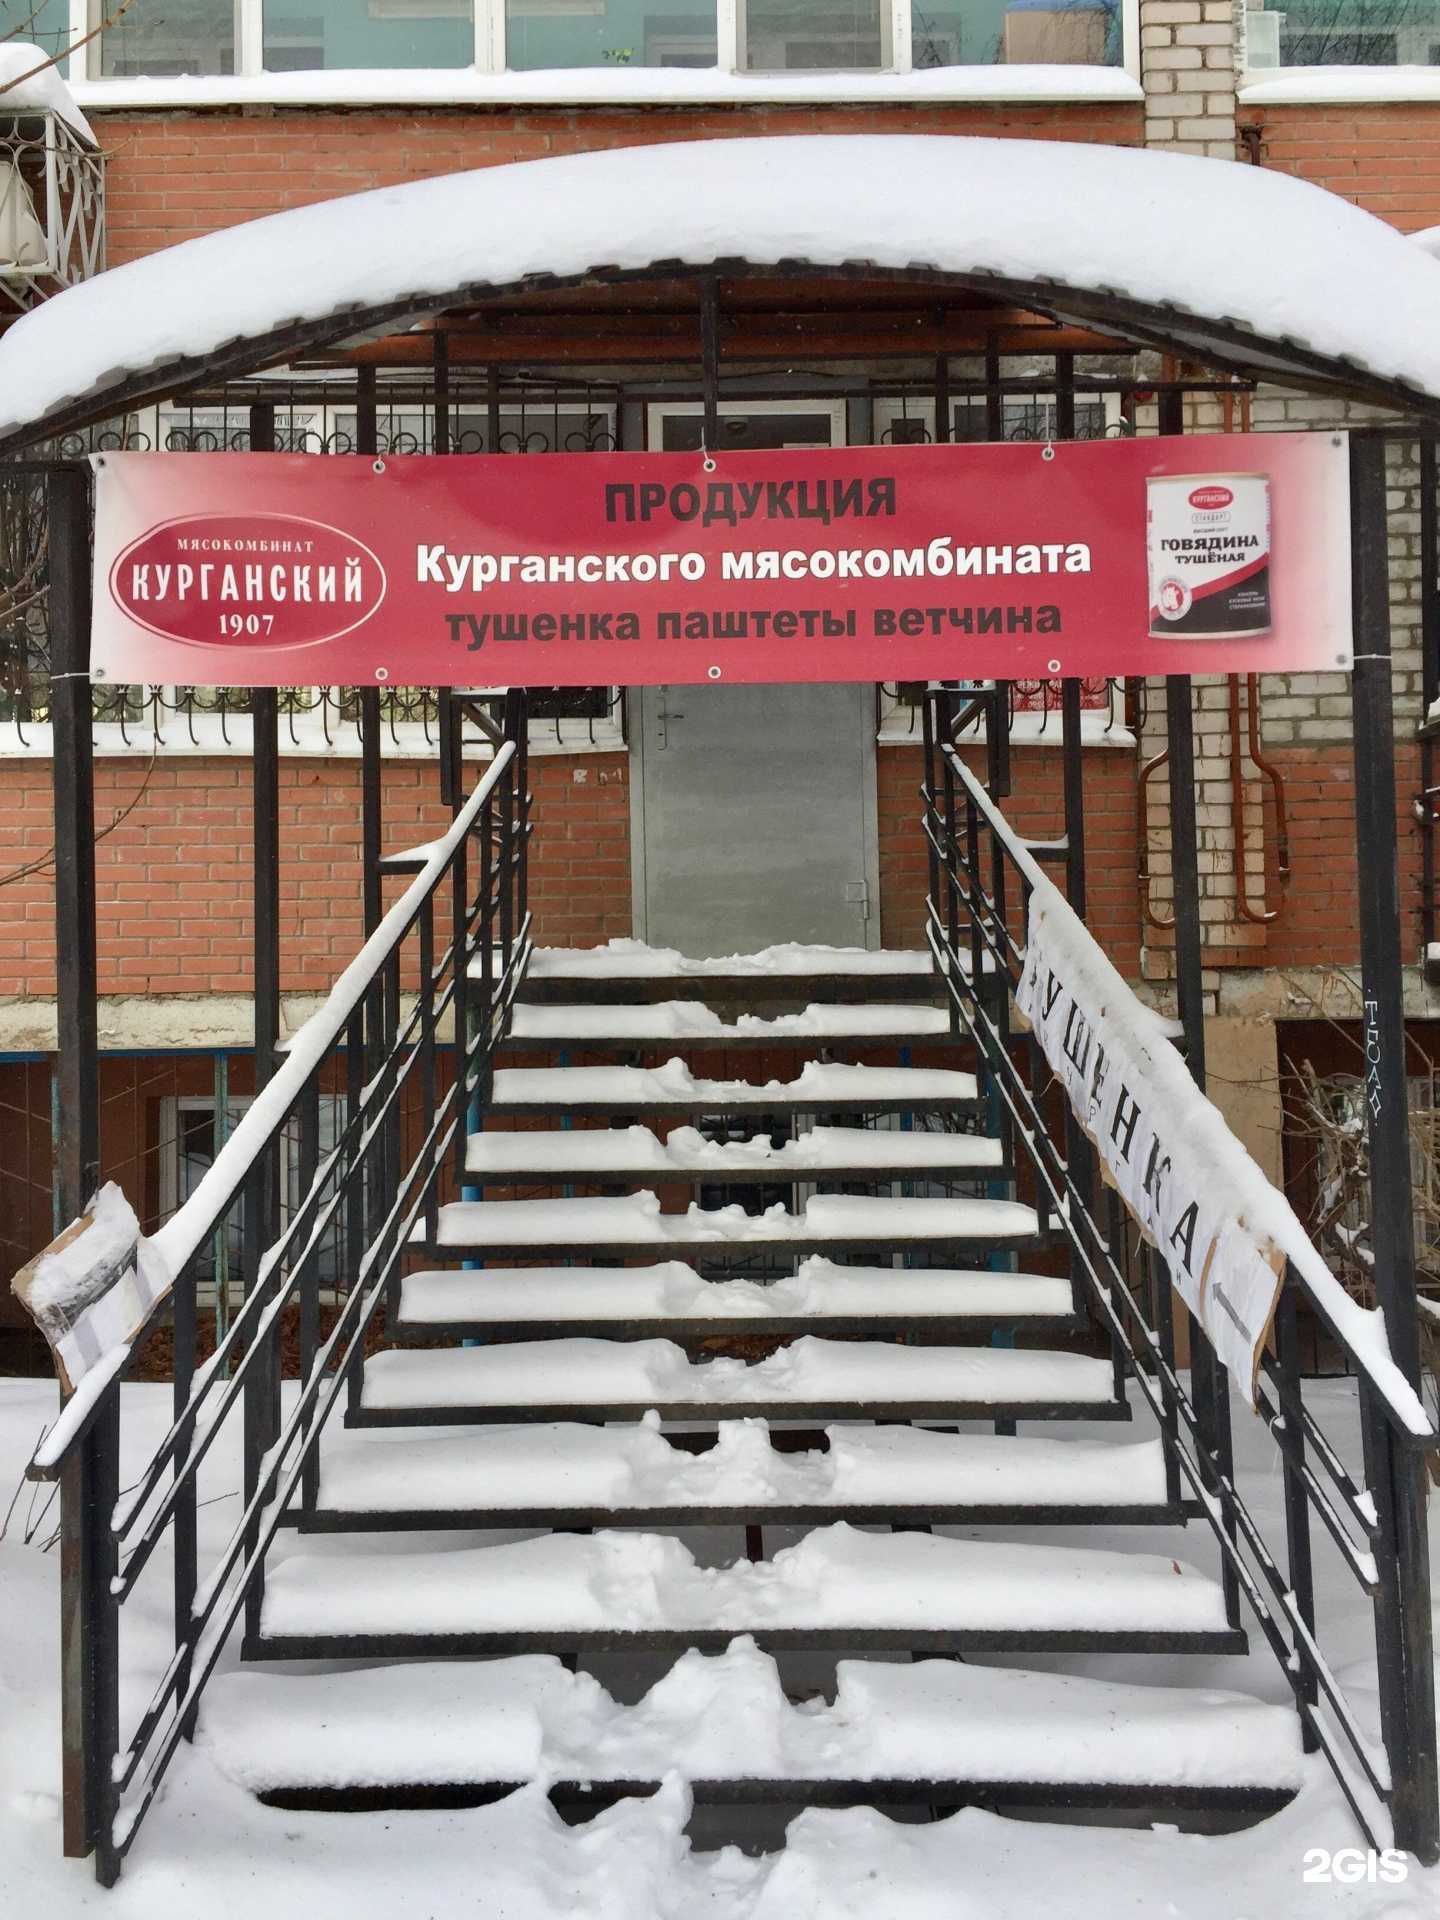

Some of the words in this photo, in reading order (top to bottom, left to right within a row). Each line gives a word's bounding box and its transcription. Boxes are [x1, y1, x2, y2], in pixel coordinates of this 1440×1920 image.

[605, 478, 896, 528] ПРОДУКЦИЯ
[177, 538, 314, 553] МЯСОКОМБИНАТ
[1161, 534, 1259, 551] ГОВЯДИНА
[1175, 552, 1245, 565] ТУШЁНАЯ
[132, 557, 362, 602] КУРГАНСКИЙ
[416, 543, 706, 592] Курганского
[721, 536, 1092, 580] мясокомбината
[219, 614, 274, 637] 1907
[445, 610, 640, 652] тушенка
[657, 608, 856, 639] паштеты
[874, 603, 1062, 636] ветчина
